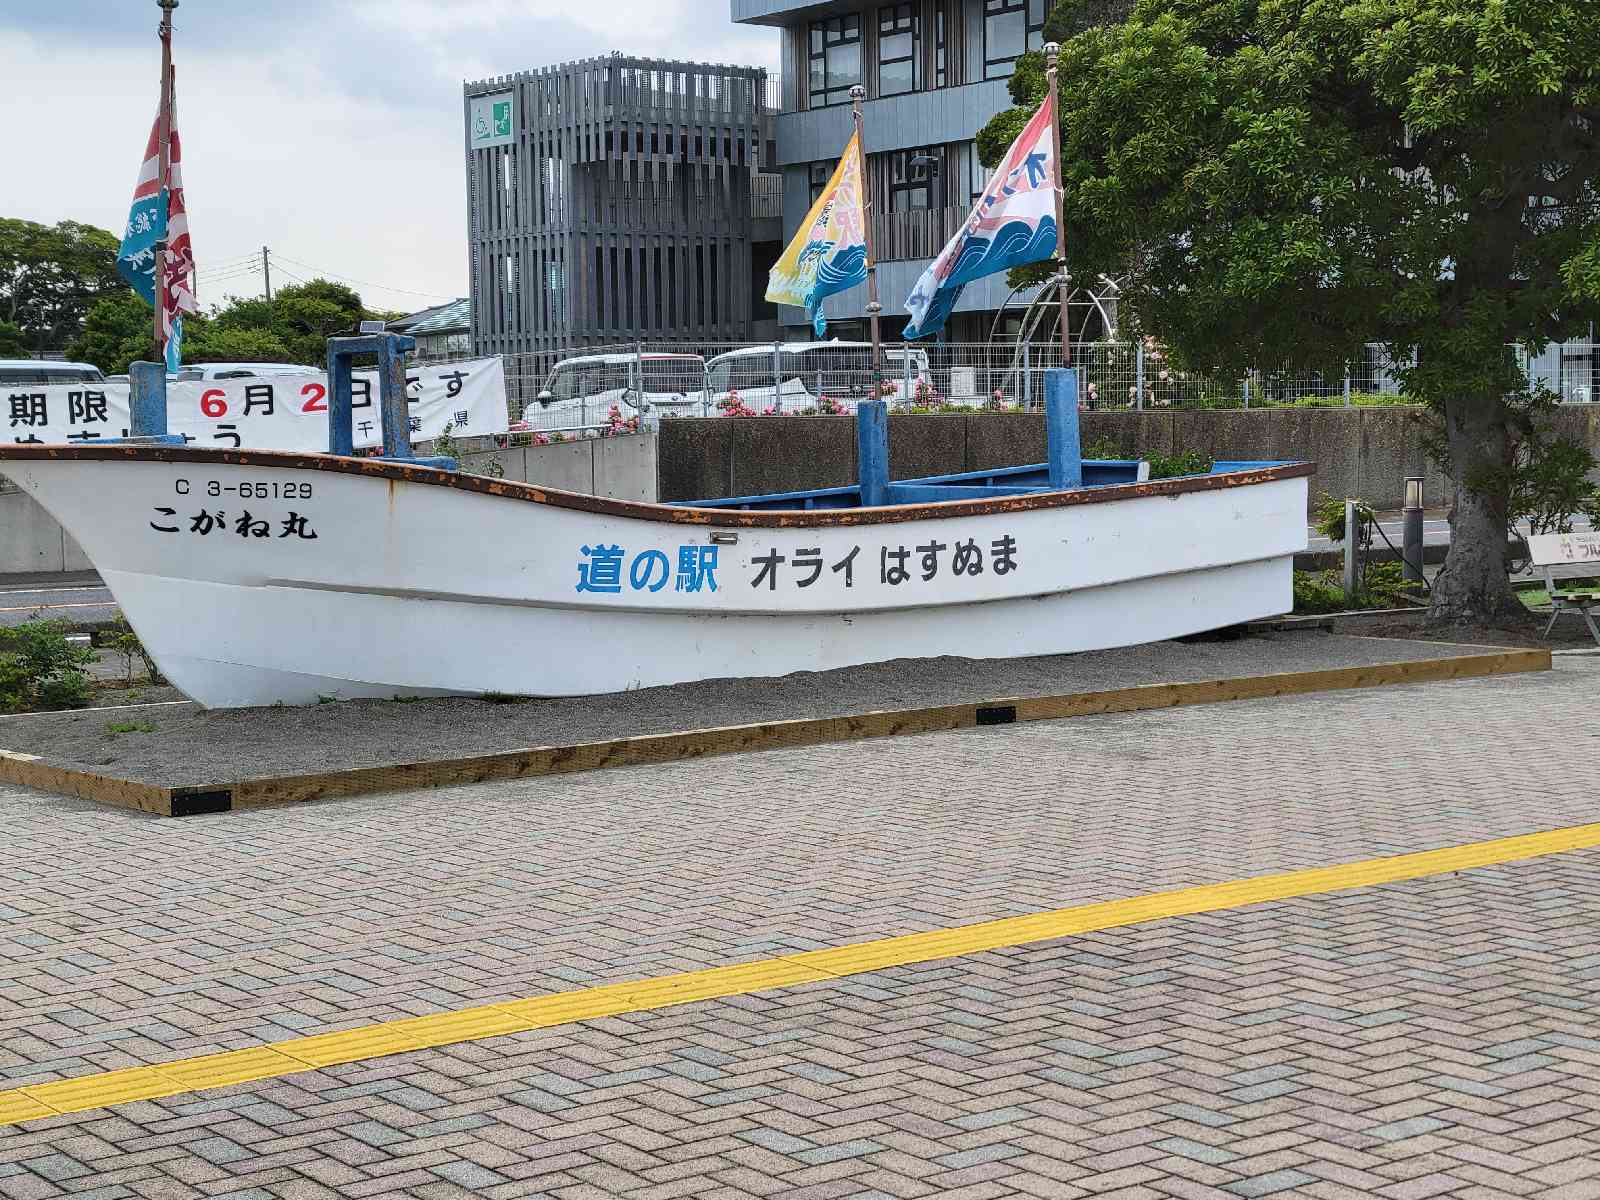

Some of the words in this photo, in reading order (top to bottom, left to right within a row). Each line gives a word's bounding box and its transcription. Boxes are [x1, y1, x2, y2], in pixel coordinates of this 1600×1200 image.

[175, 479, 190, 495] C
[207, 480, 313, 499] 3-65129
[150, 507, 318, 539] こがね丸
[575, 543, 720, 594] 道の駅
